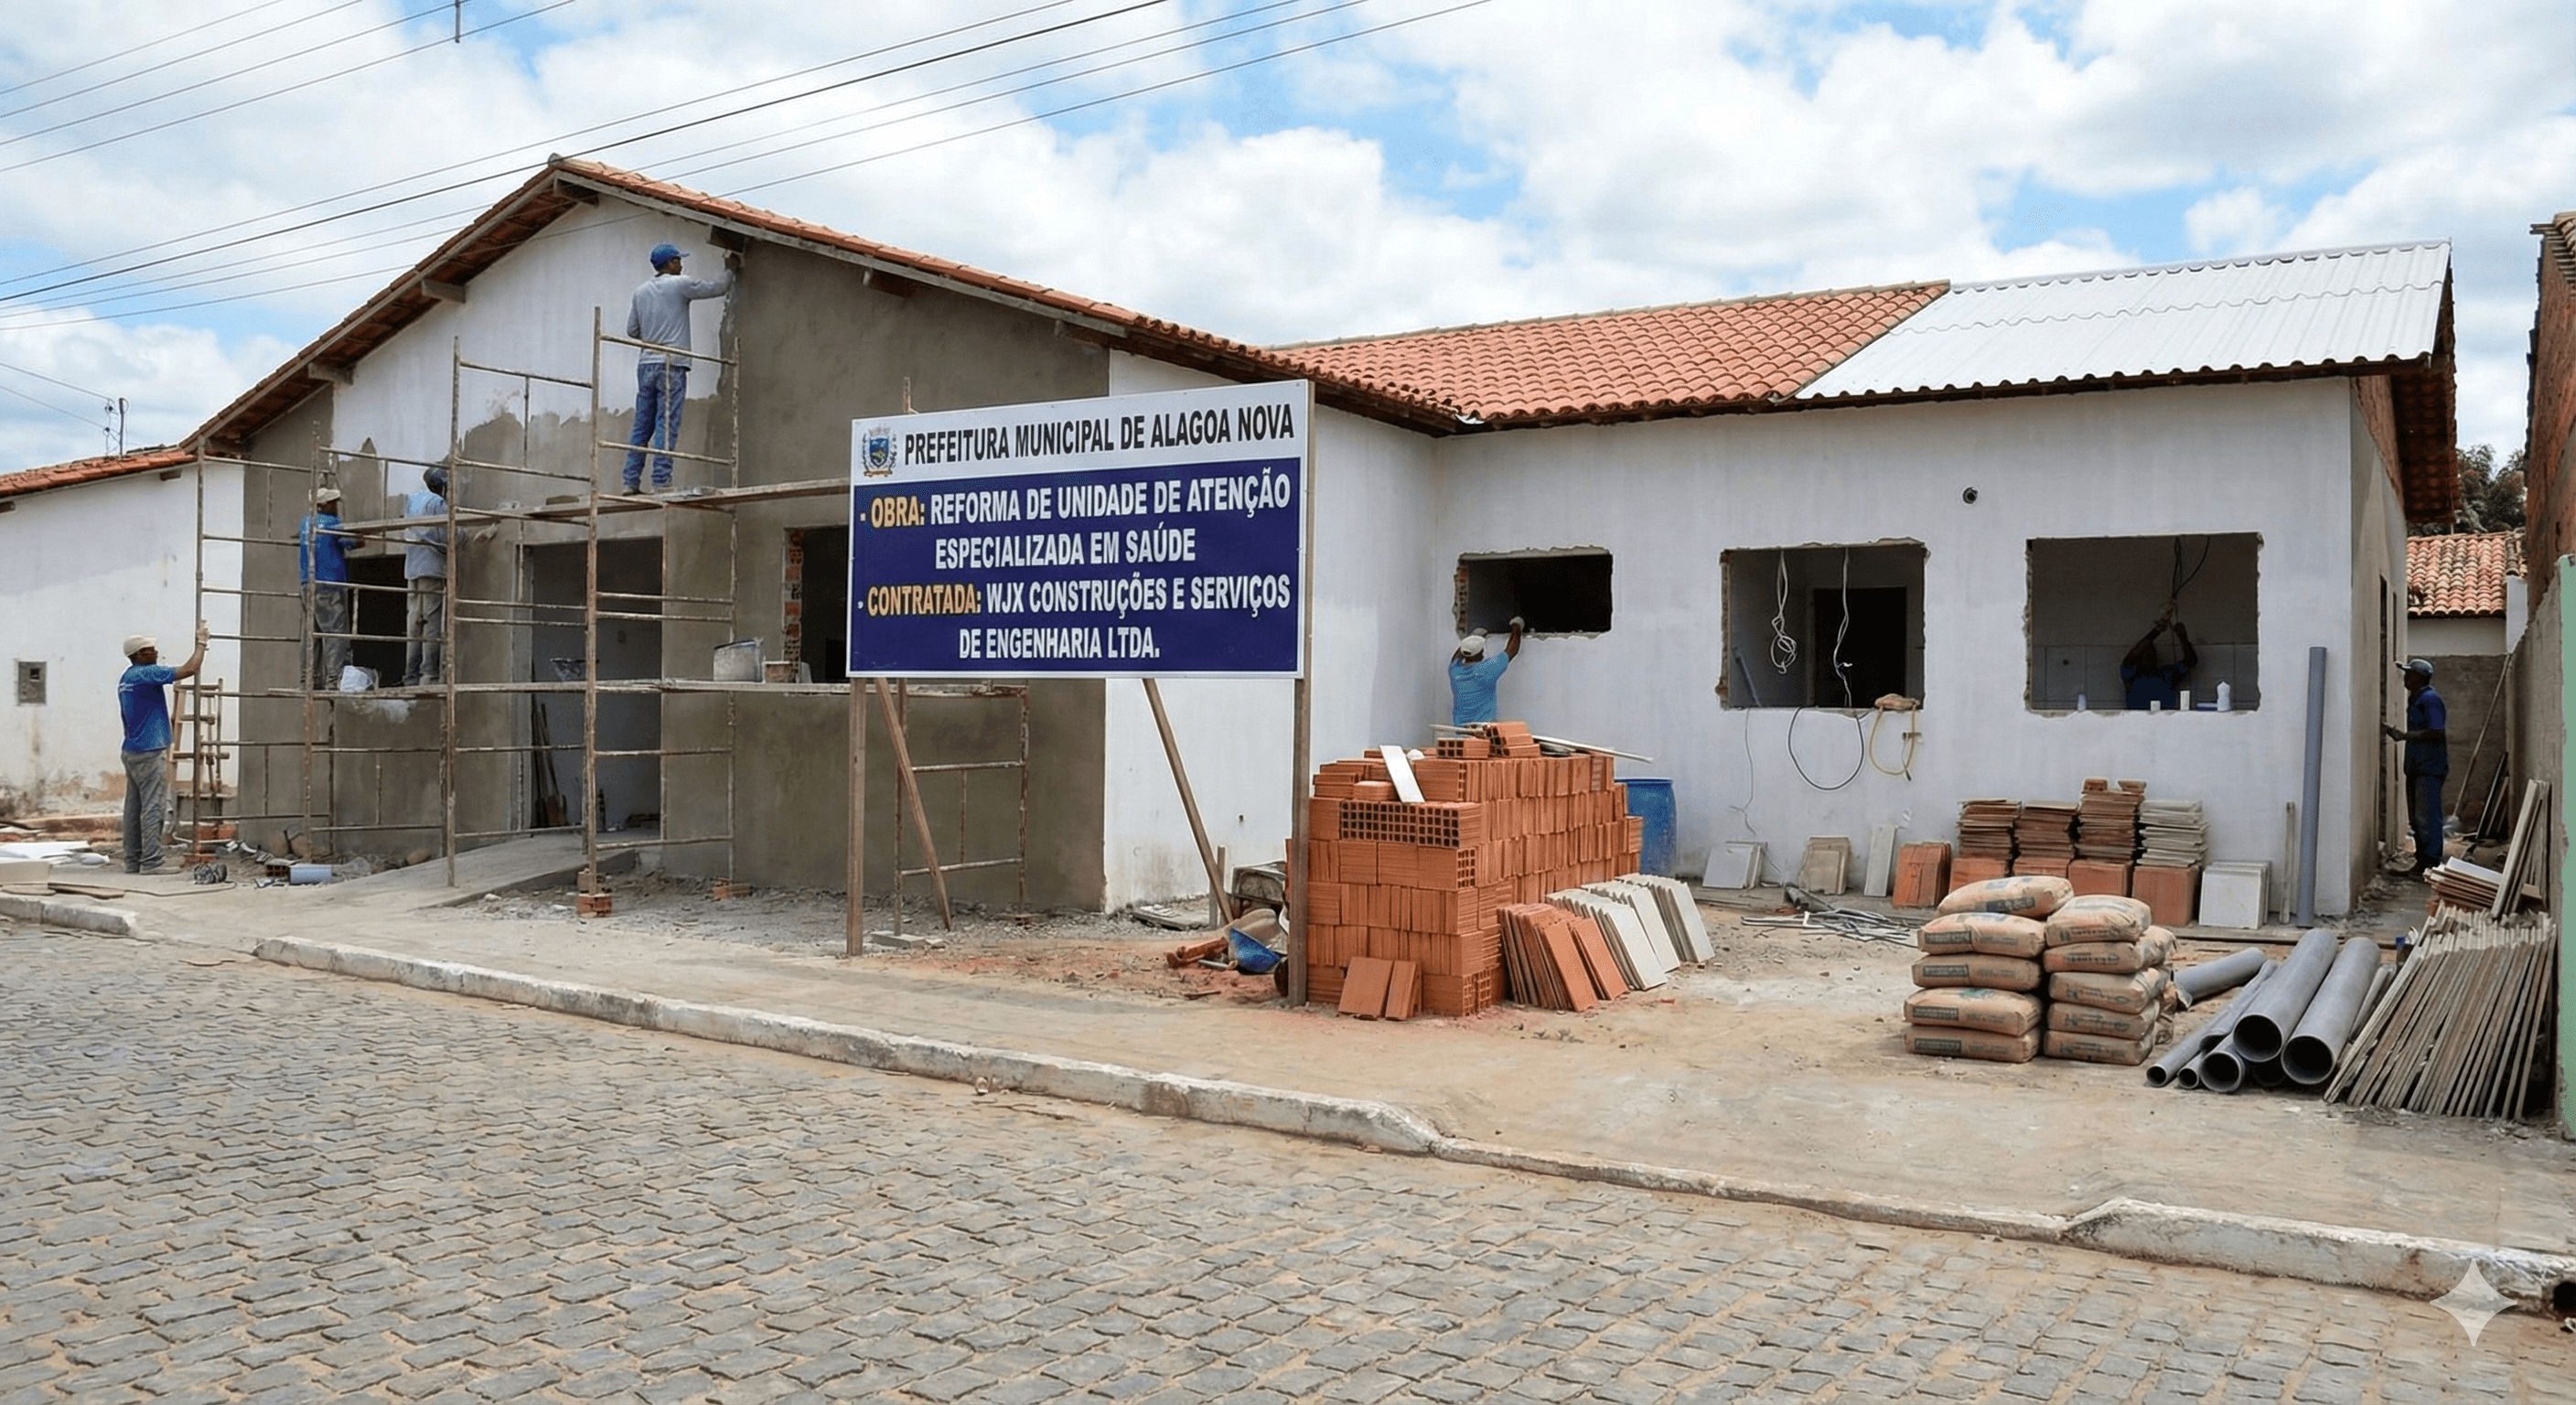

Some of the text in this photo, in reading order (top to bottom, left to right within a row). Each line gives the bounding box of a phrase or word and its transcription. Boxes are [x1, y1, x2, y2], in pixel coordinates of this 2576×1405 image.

[905, 403, 1294, 466] PREFEITURA MUNICIPAL DE ALAGOA NOVA
[871, 467, 1291, 528] OBRA: REFORMA DE UNIDADE DE ATENÇÃO
[935, 521, 1196, 570] ESPECIALIZADA EM SAÚDE
[867, 571, 1291, 619] CONTRATADA: WJX CONSTRUÇÕES E SERVIÇOS
[959, 627, 1160, 659] DE ENGENHARIA LTDA.
